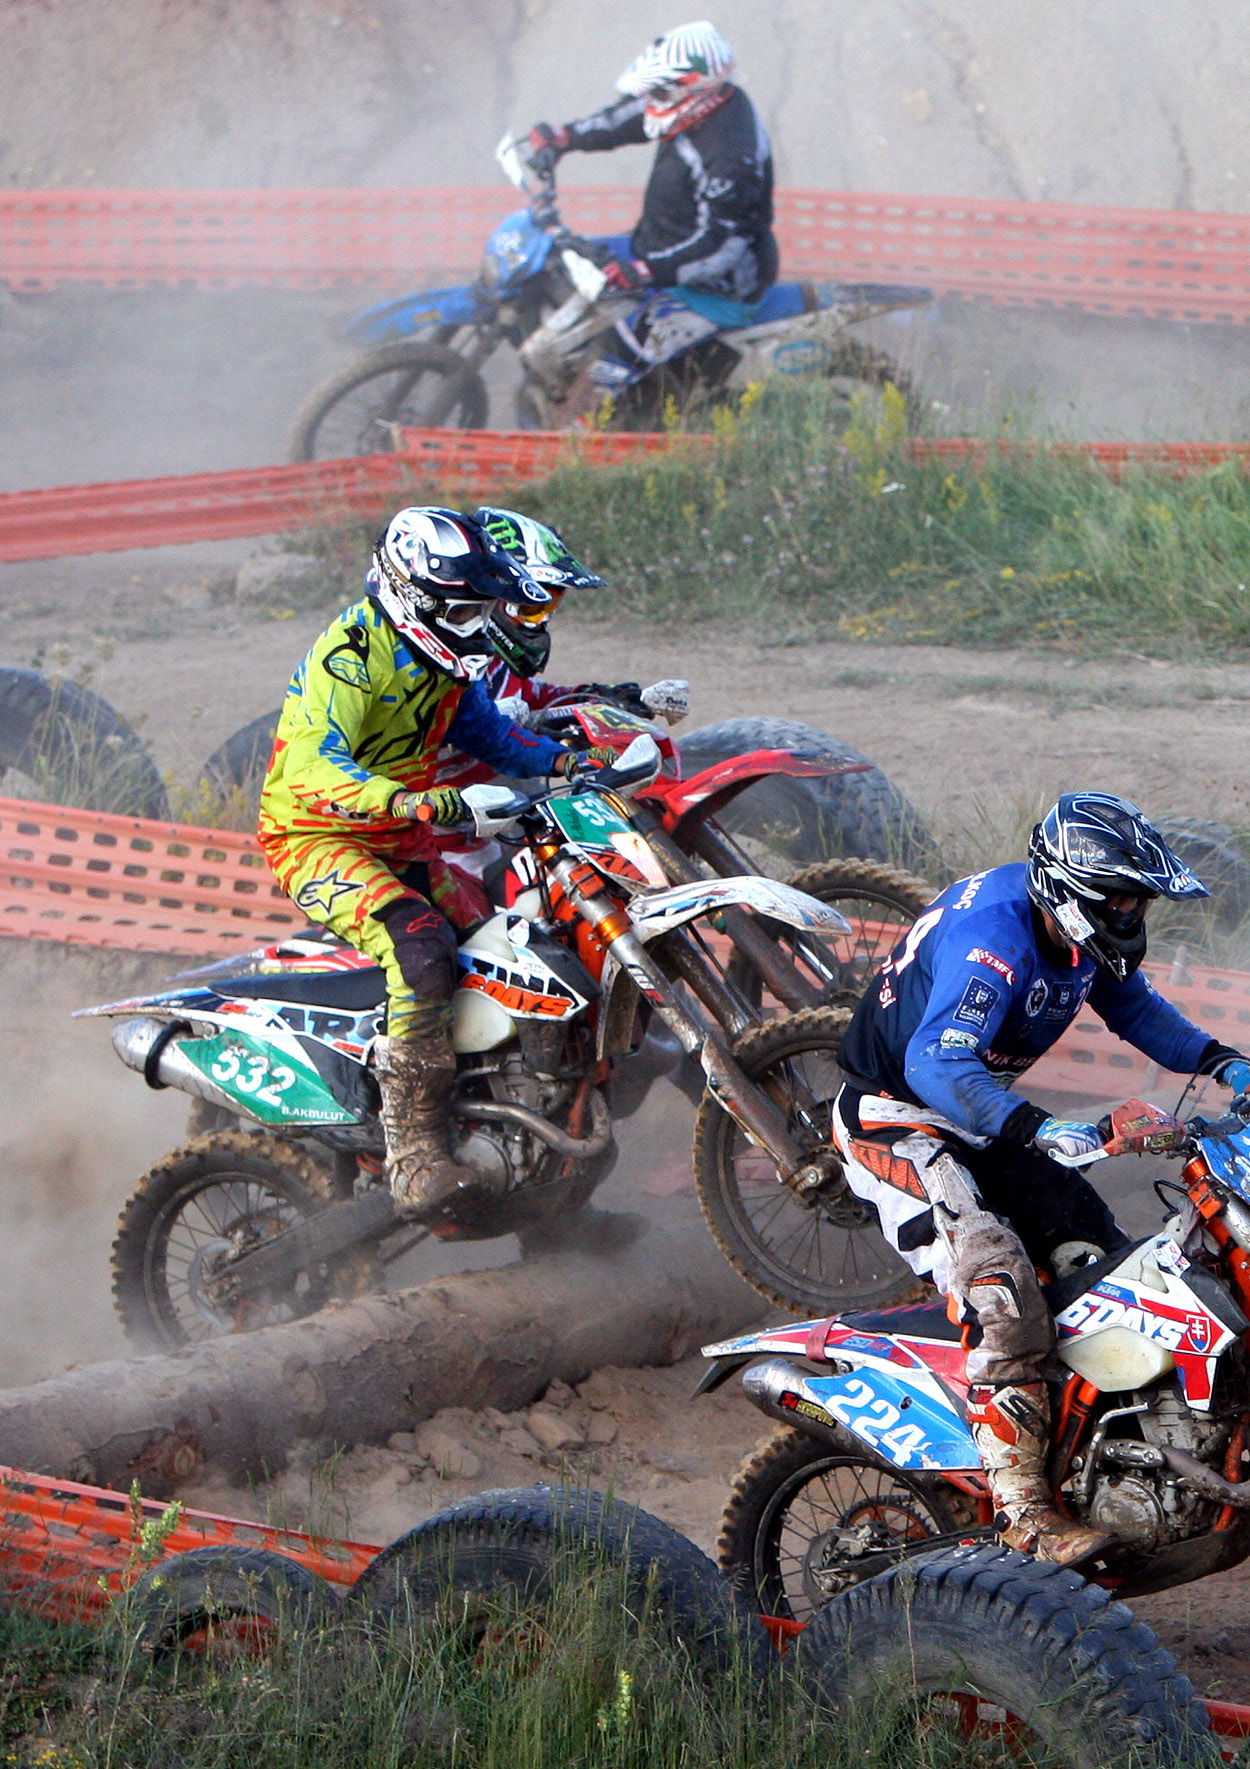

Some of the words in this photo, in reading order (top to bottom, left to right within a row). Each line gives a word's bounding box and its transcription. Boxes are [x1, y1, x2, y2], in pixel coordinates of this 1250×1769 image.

[211, 1046, 296, 1107] 532
[1055, 1299, 1190, 1350] 6DAYS
[825, 1379, 930, 1467] 224
